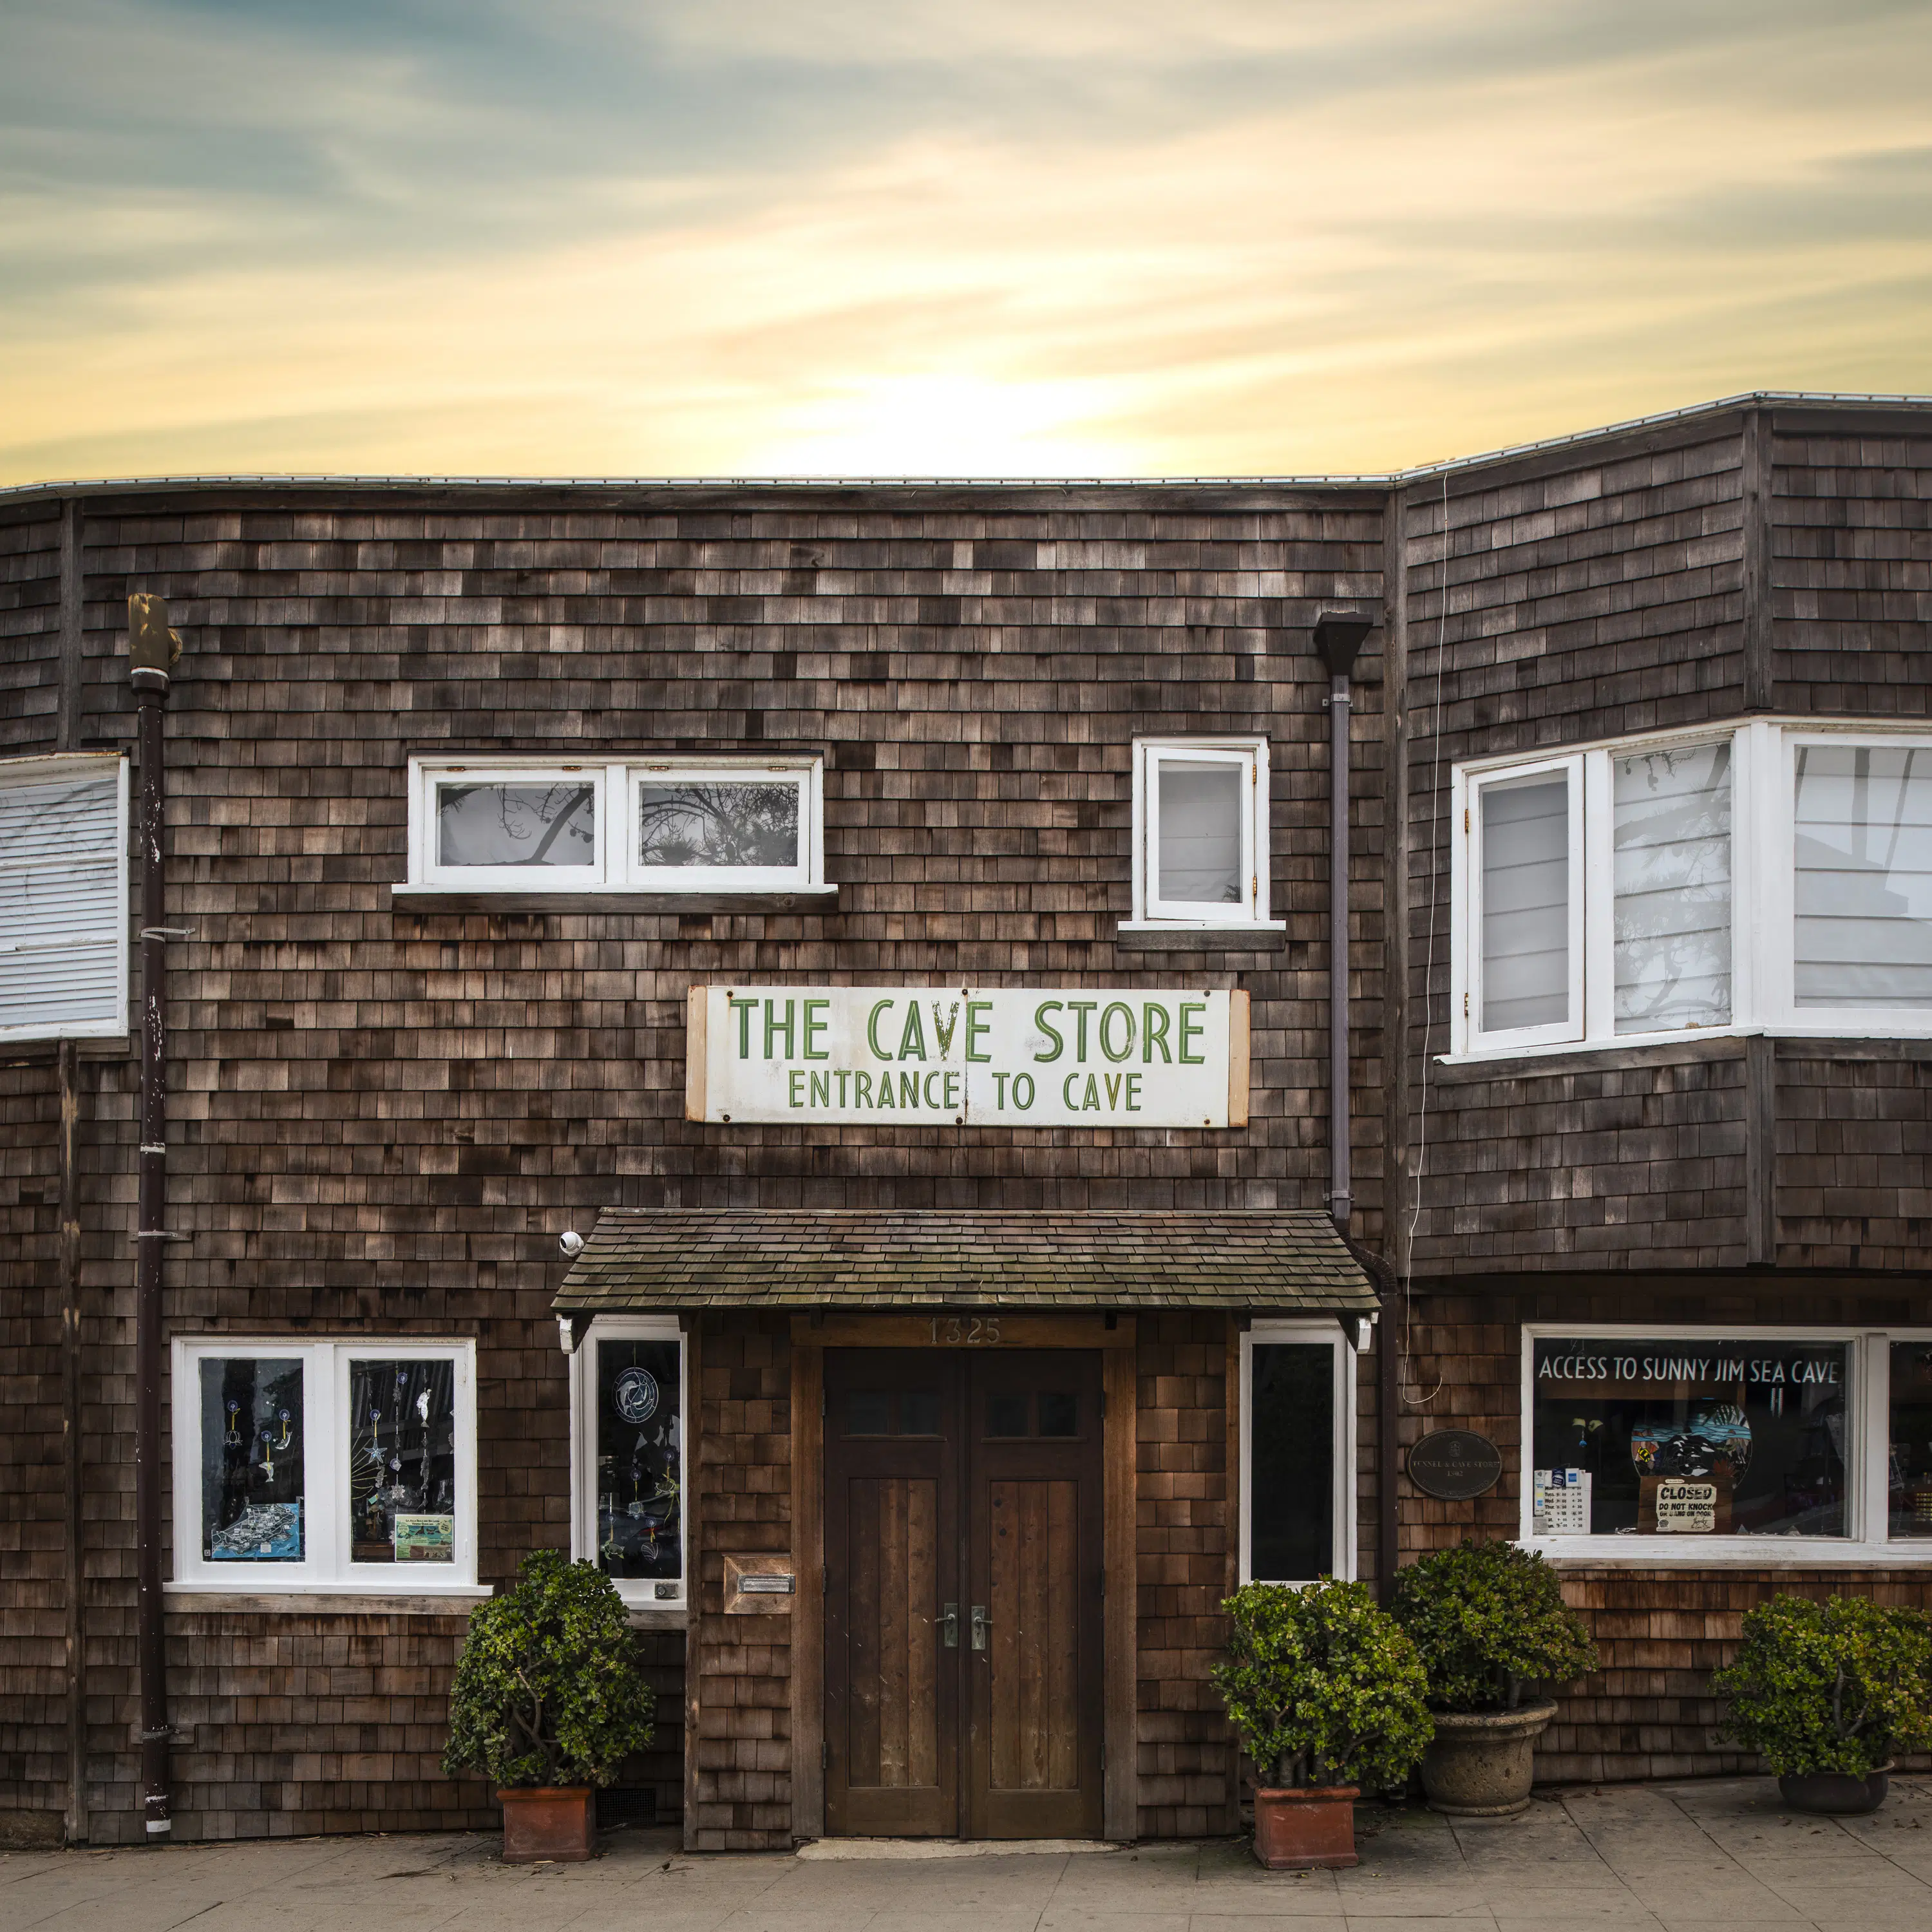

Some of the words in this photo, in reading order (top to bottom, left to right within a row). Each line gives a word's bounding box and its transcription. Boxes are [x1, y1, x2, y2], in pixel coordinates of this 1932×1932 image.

[730, 998, 830, 1060] THE
[867, 999, 994, 1063] CAVE
[1033, 1001, 1206, 1064] STORE
[789, 1070, 960, 1110] ENTRANCE
[992, 1072, 1035, 1111] TO
[1063, 1072, 1142, 1112] CAVE
[928, 1317, 1000, 1345] 1325
[1539, 1355, 1607, 1379] ACCESS
[1614, 1356, 1638, 1380] TO
[1642, 1357, 1711, 1381] SUNNY
[1714, 1358, 1745, 1383] JIM
[1750, 1359, 1785, 1383] SEA
[1792, 1360, 1839, 1384] CAVE
[1660, 1486, 1712, 1500] CLOSED
